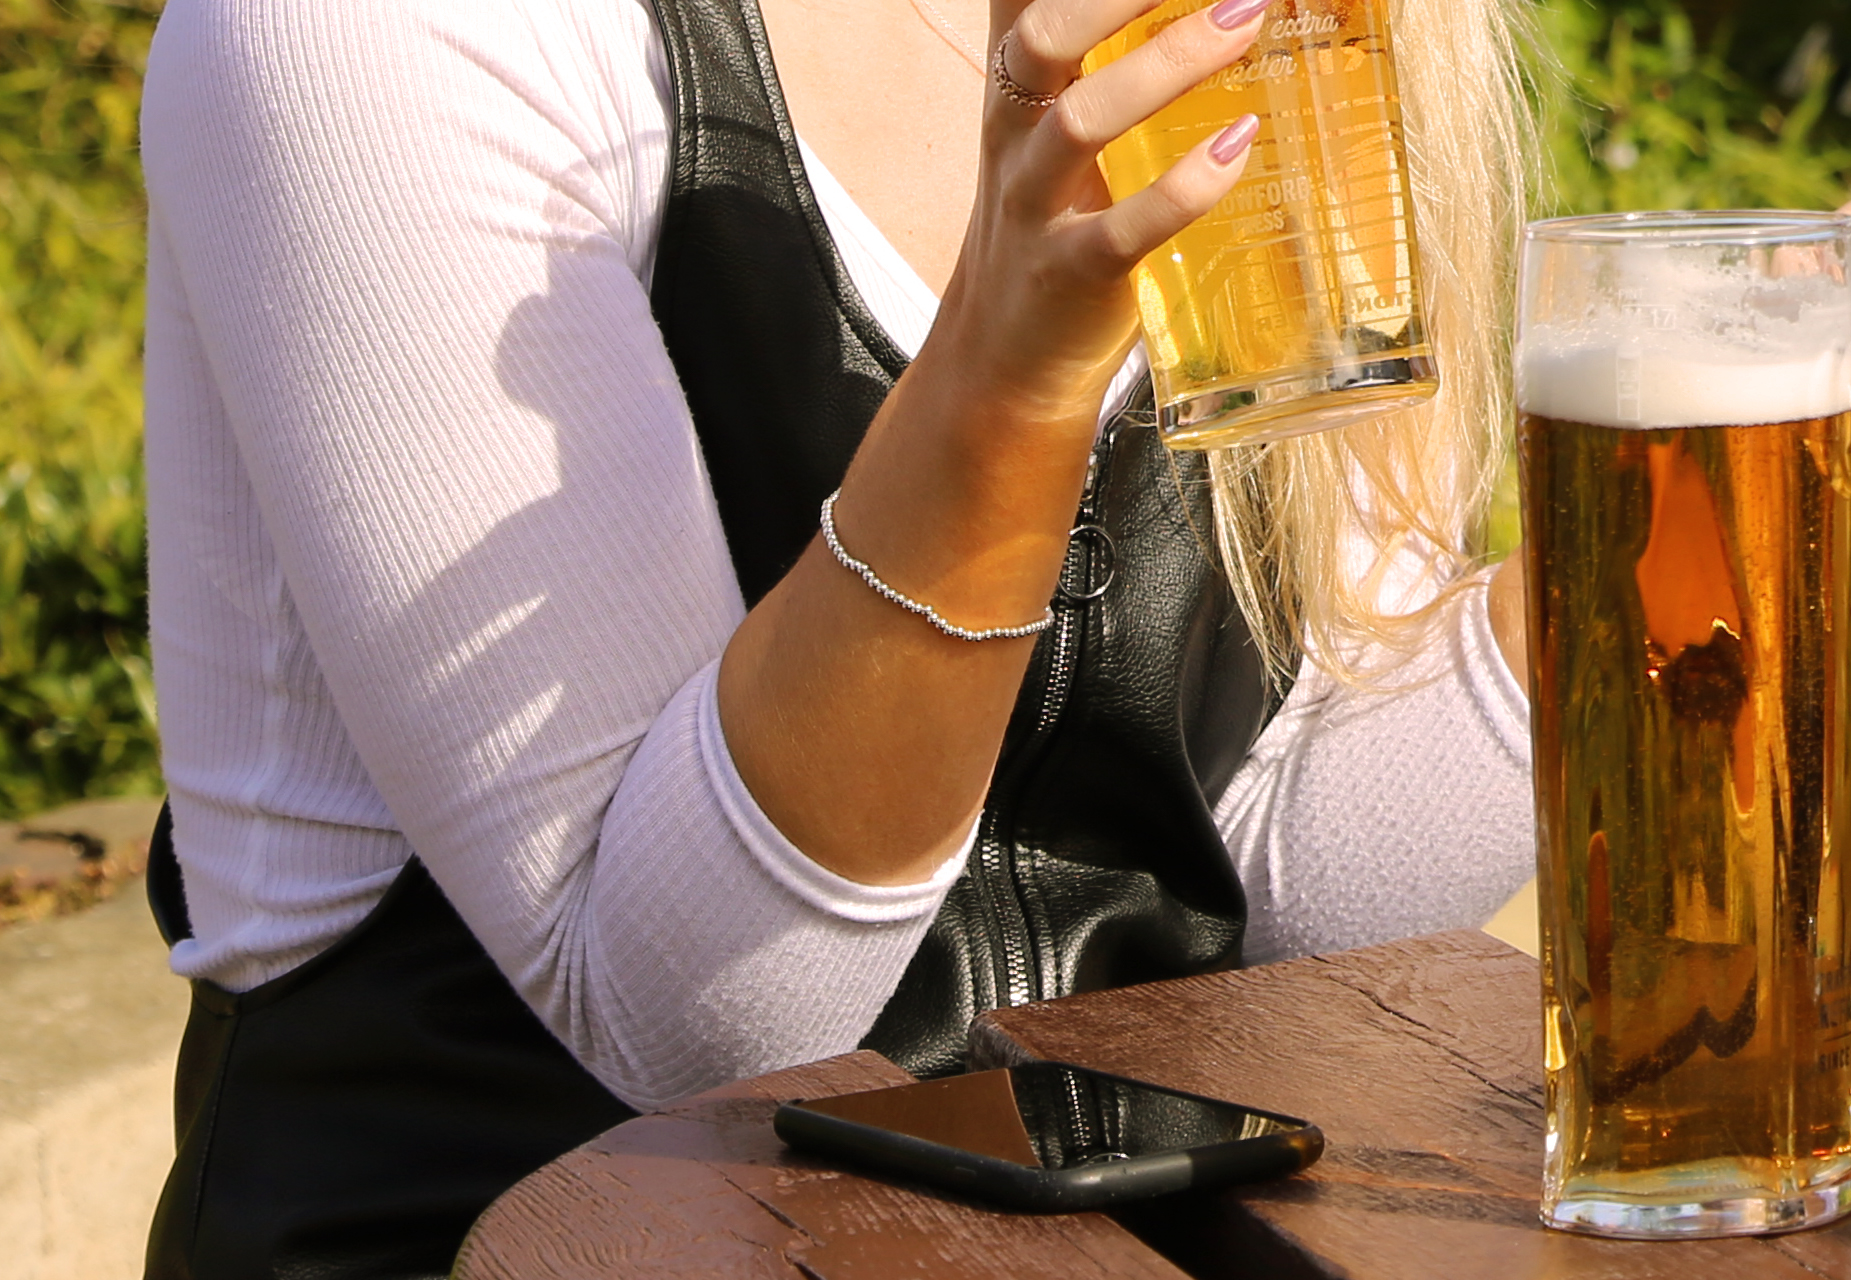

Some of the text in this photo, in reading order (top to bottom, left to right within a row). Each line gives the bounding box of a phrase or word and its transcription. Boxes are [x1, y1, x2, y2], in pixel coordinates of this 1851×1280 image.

[1270, 10, 1339, 39] extra
[1199, 53, 1298, 91] racter
[1204, 175, 1310, 219] TOWFORD
[1232, 209, 1285, 236] PRESS
